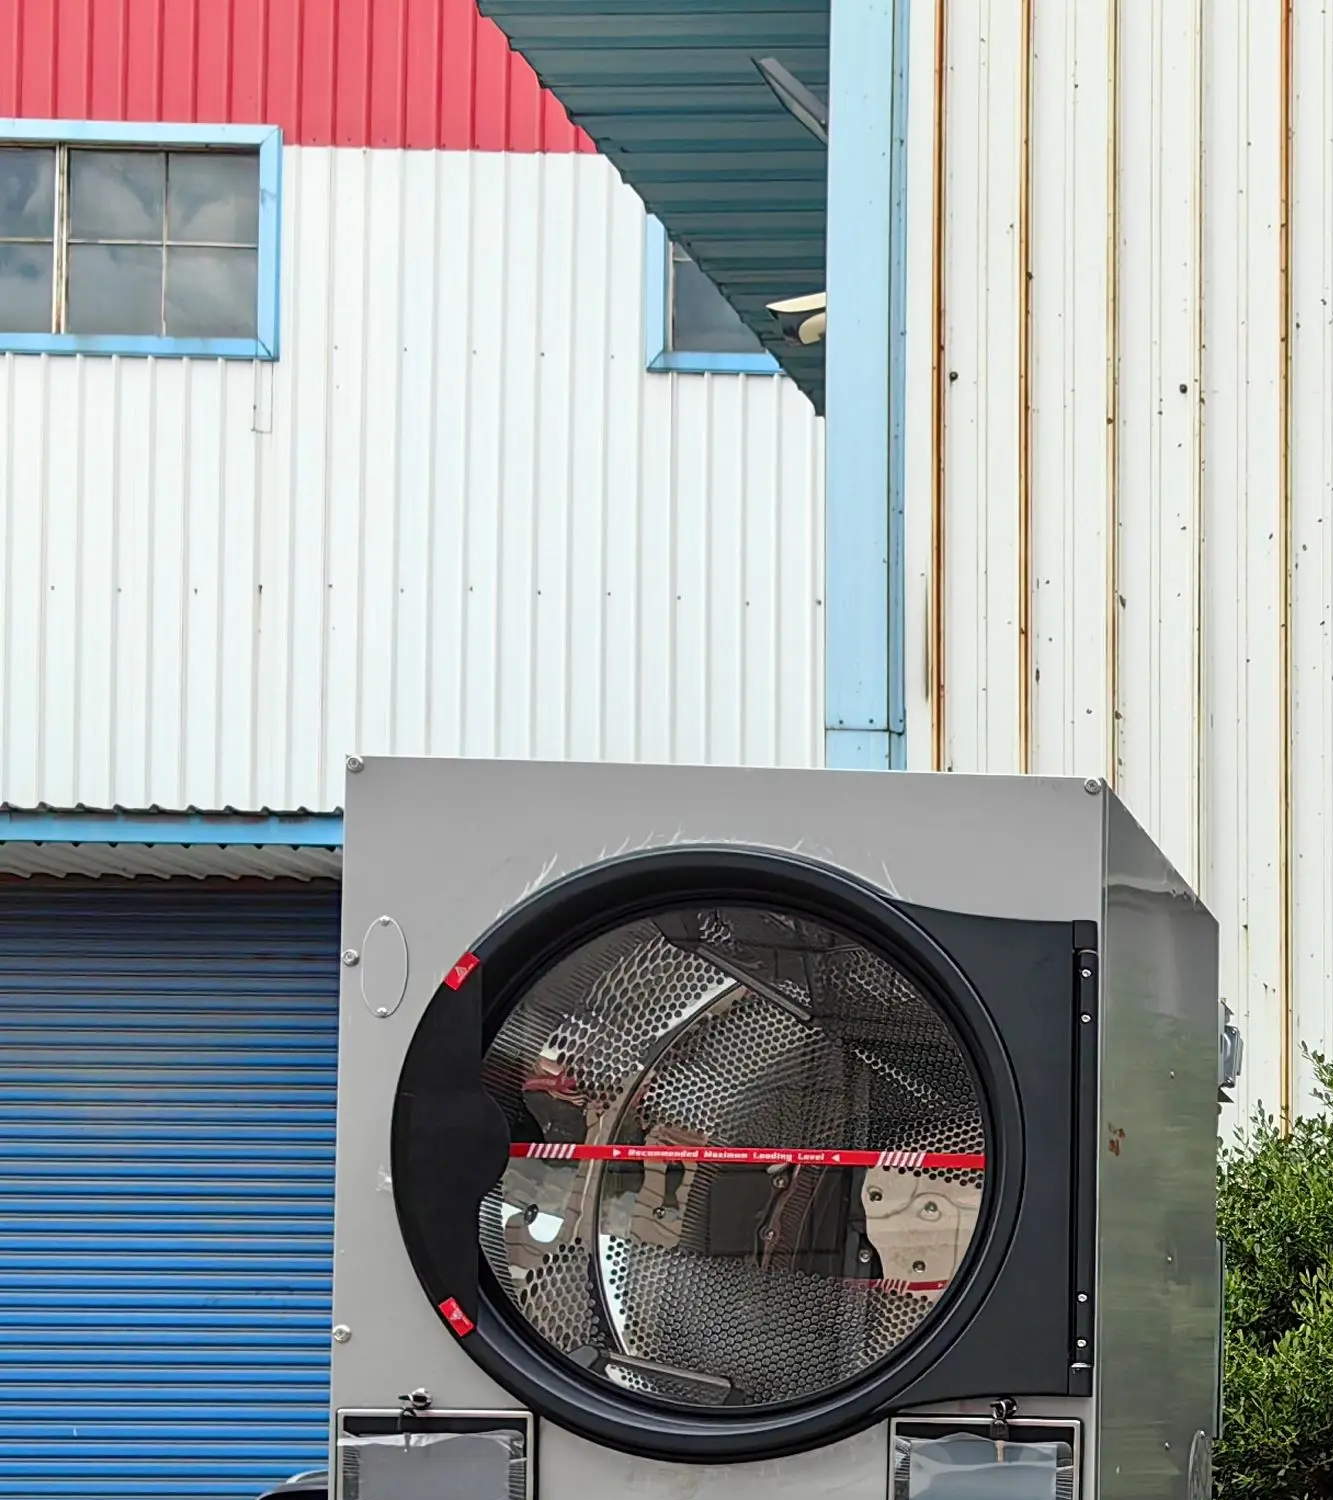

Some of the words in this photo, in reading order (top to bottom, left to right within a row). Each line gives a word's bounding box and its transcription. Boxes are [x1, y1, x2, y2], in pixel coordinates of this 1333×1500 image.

[628, 1149, 699, 1158] Recommended
[703, 1150, 748, 1159] Maximum
[753, 1152, 793, 1162] Loading
[798, 1153, 825, 1161] Level
